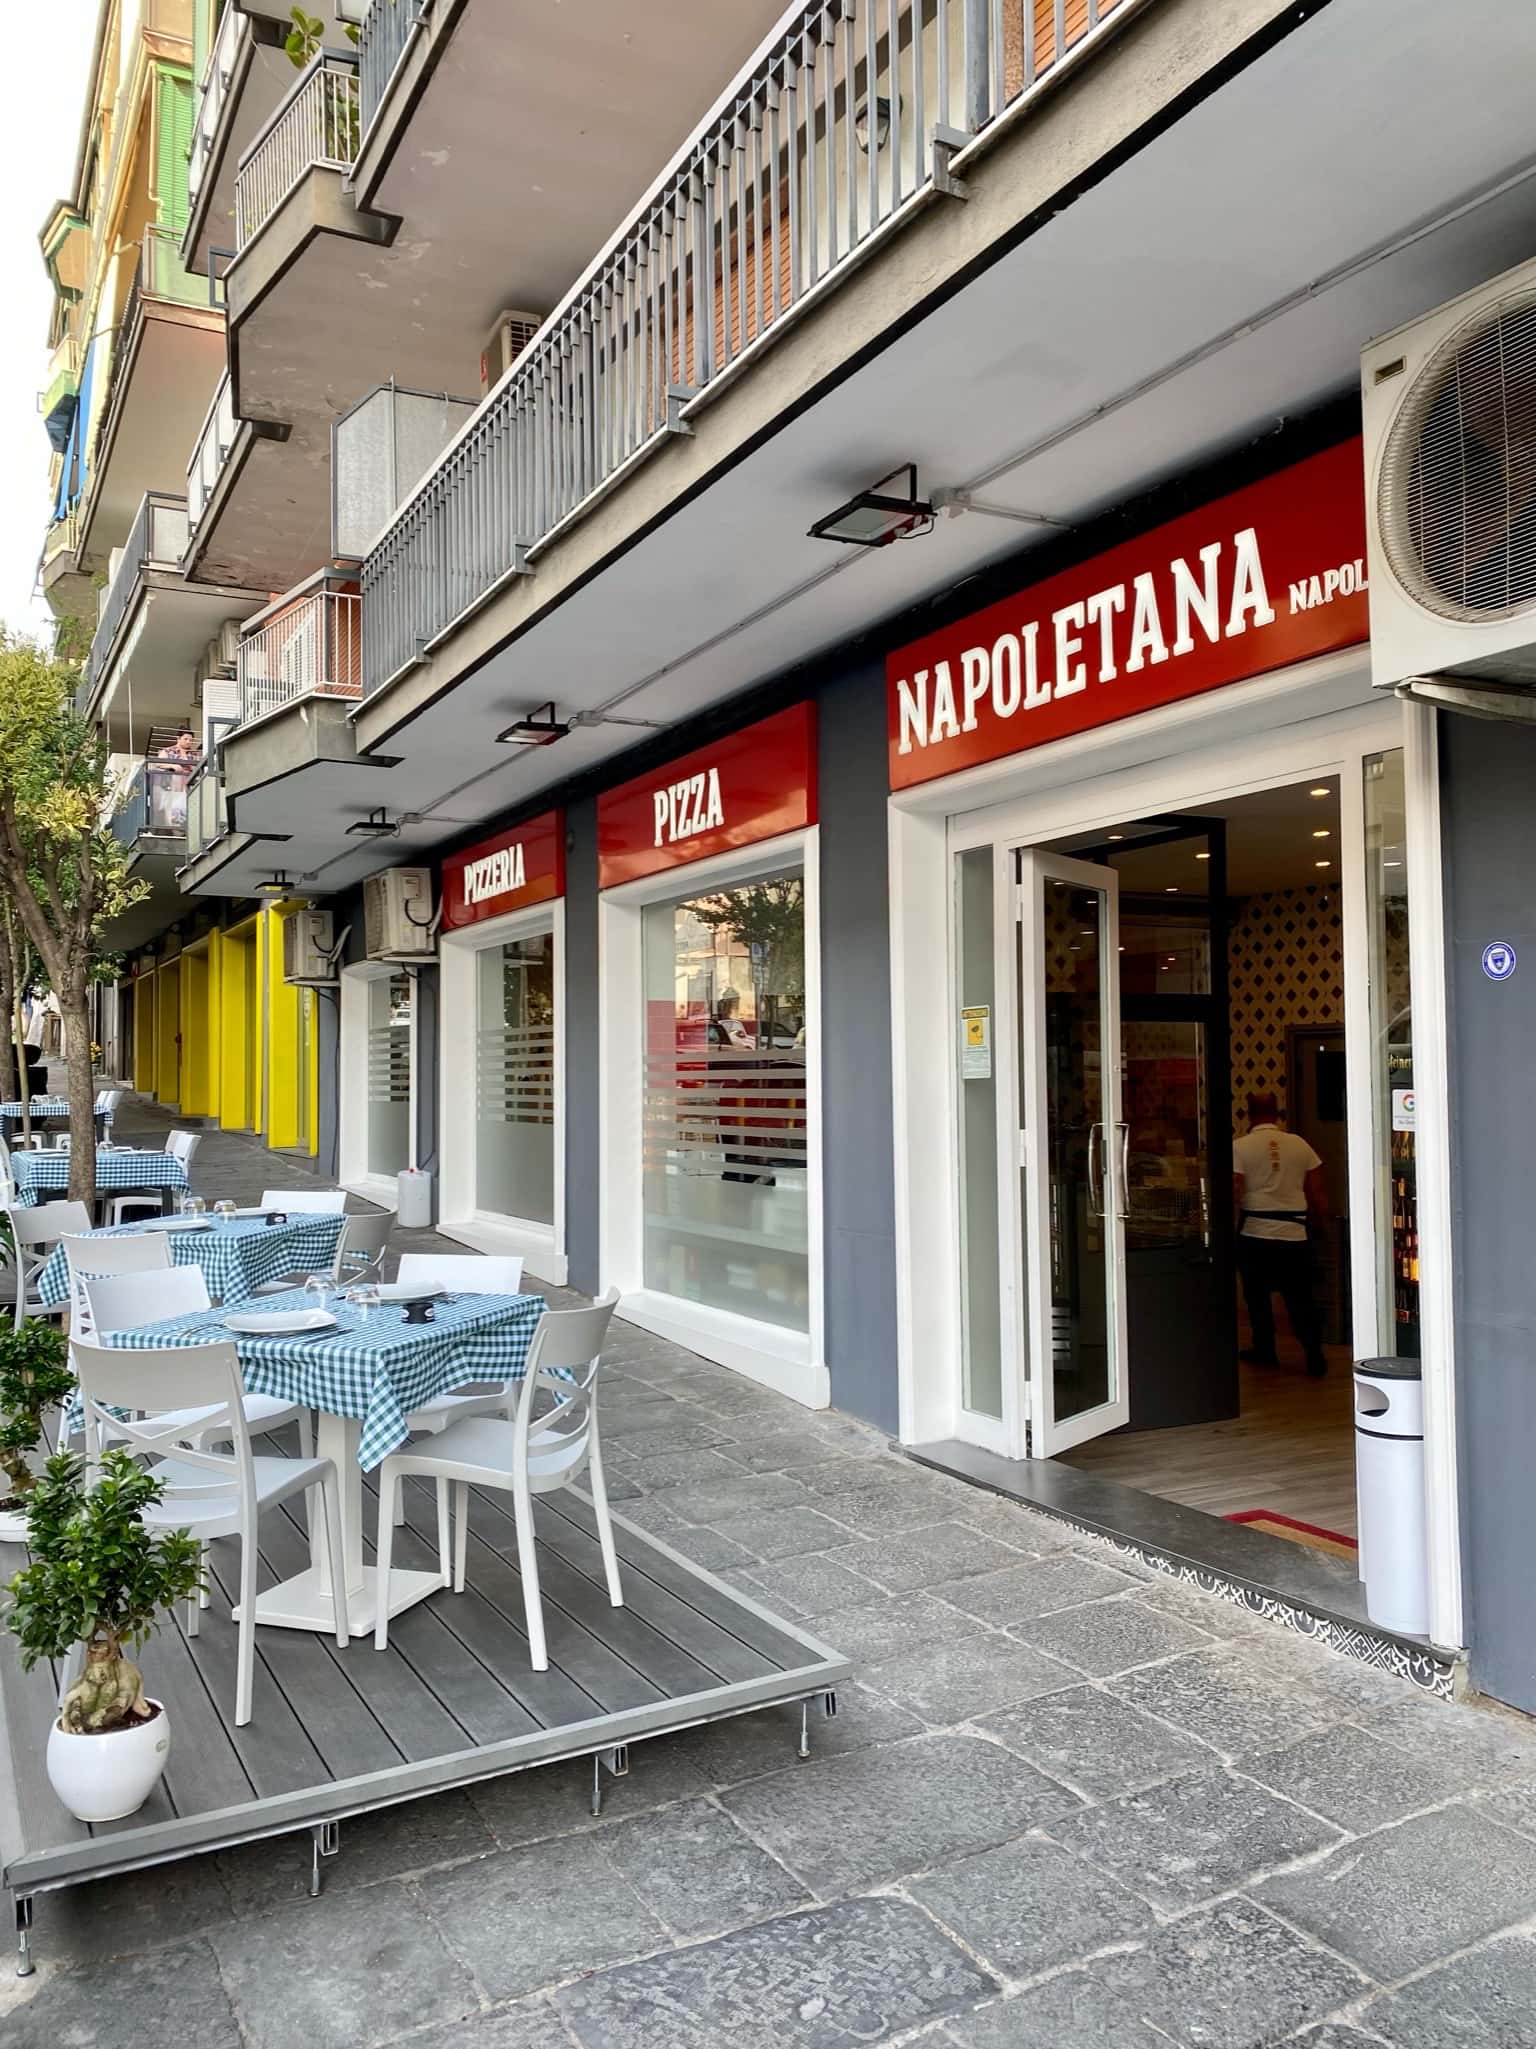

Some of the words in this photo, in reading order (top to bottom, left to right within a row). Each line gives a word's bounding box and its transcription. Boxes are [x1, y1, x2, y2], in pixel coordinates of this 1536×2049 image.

[897, 527, 1275, 755] NAPOLETANA
[653, 767, 724, 848] PIZZA
[463, 842, 527, 906] PIZZERIA
